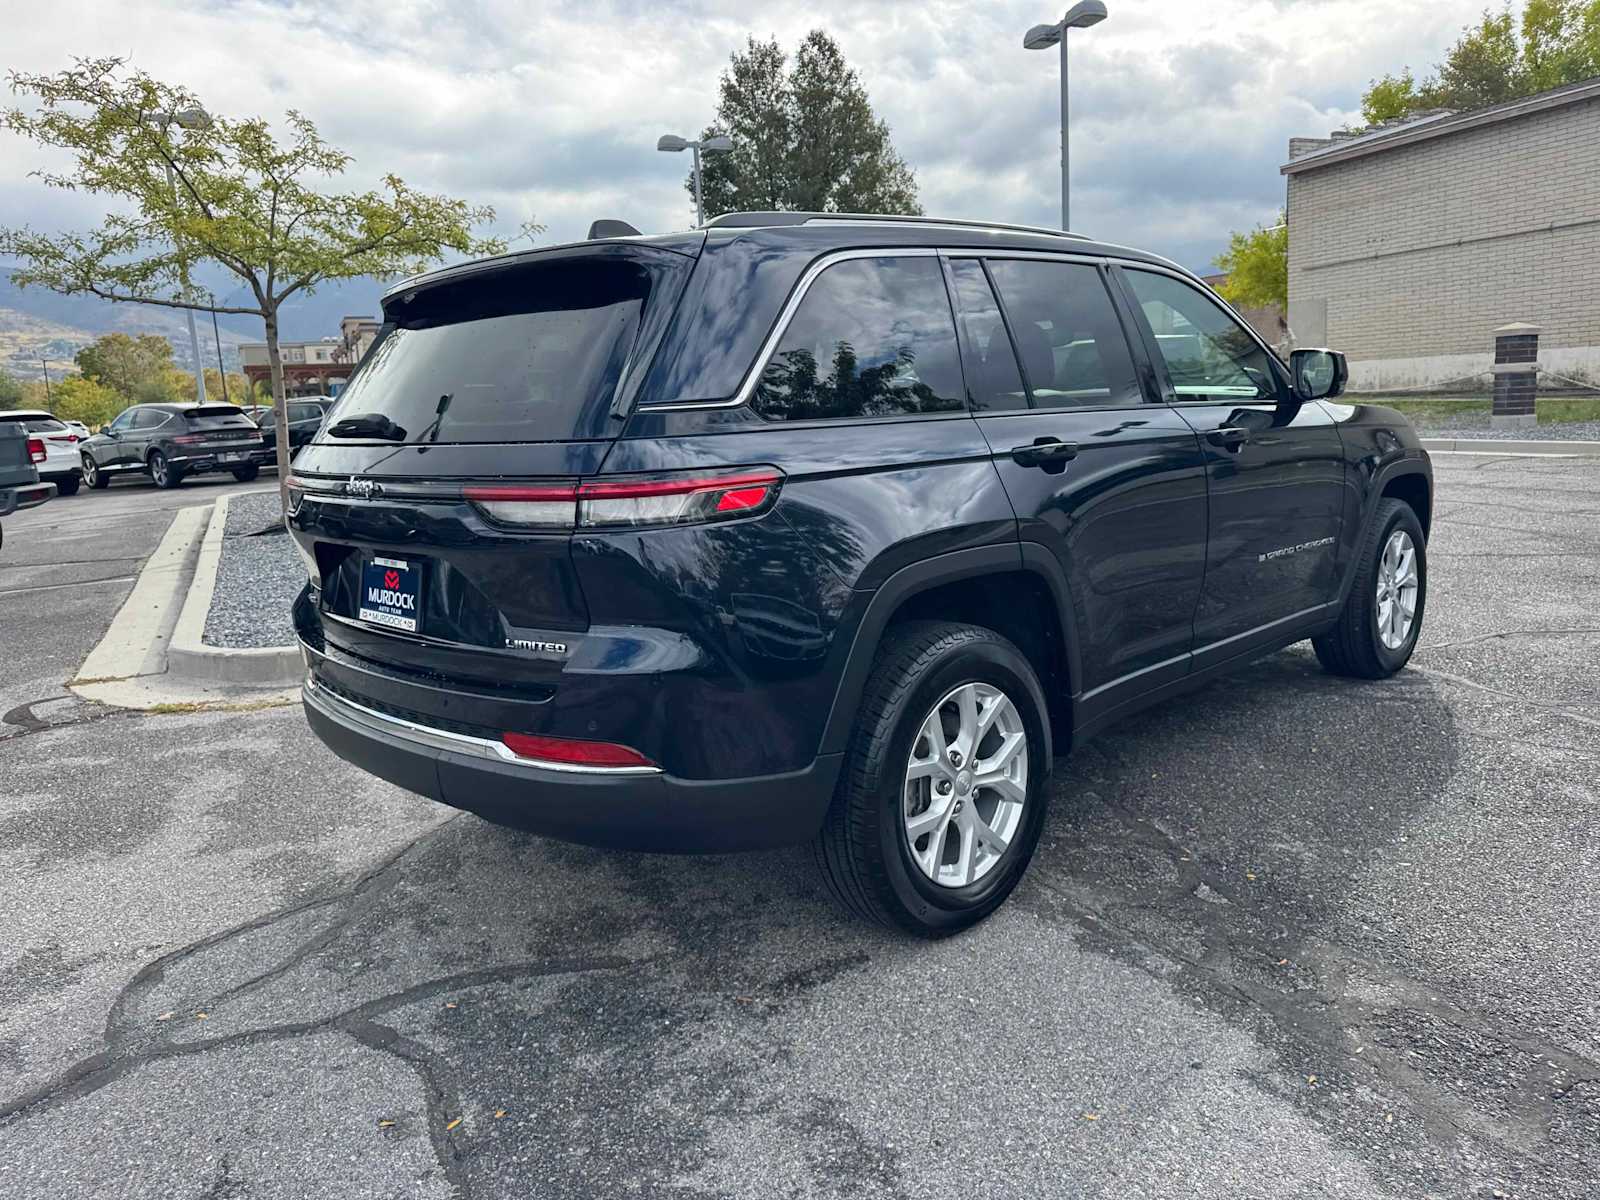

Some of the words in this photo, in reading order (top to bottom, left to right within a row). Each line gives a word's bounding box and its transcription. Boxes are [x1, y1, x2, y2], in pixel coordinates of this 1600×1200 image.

[346, 475, 374, 498] Jeep
[1266, 546, 1295, 560] GRAND
[1295, 536, 1335, 552] CHEROKEE
[368, 587, 415, 610] MURDOCK
[378, 605, 390, 613] AUTO
[390, 607, 402, 615] TEAM
[505, 638, 566, 653] LIMITED
